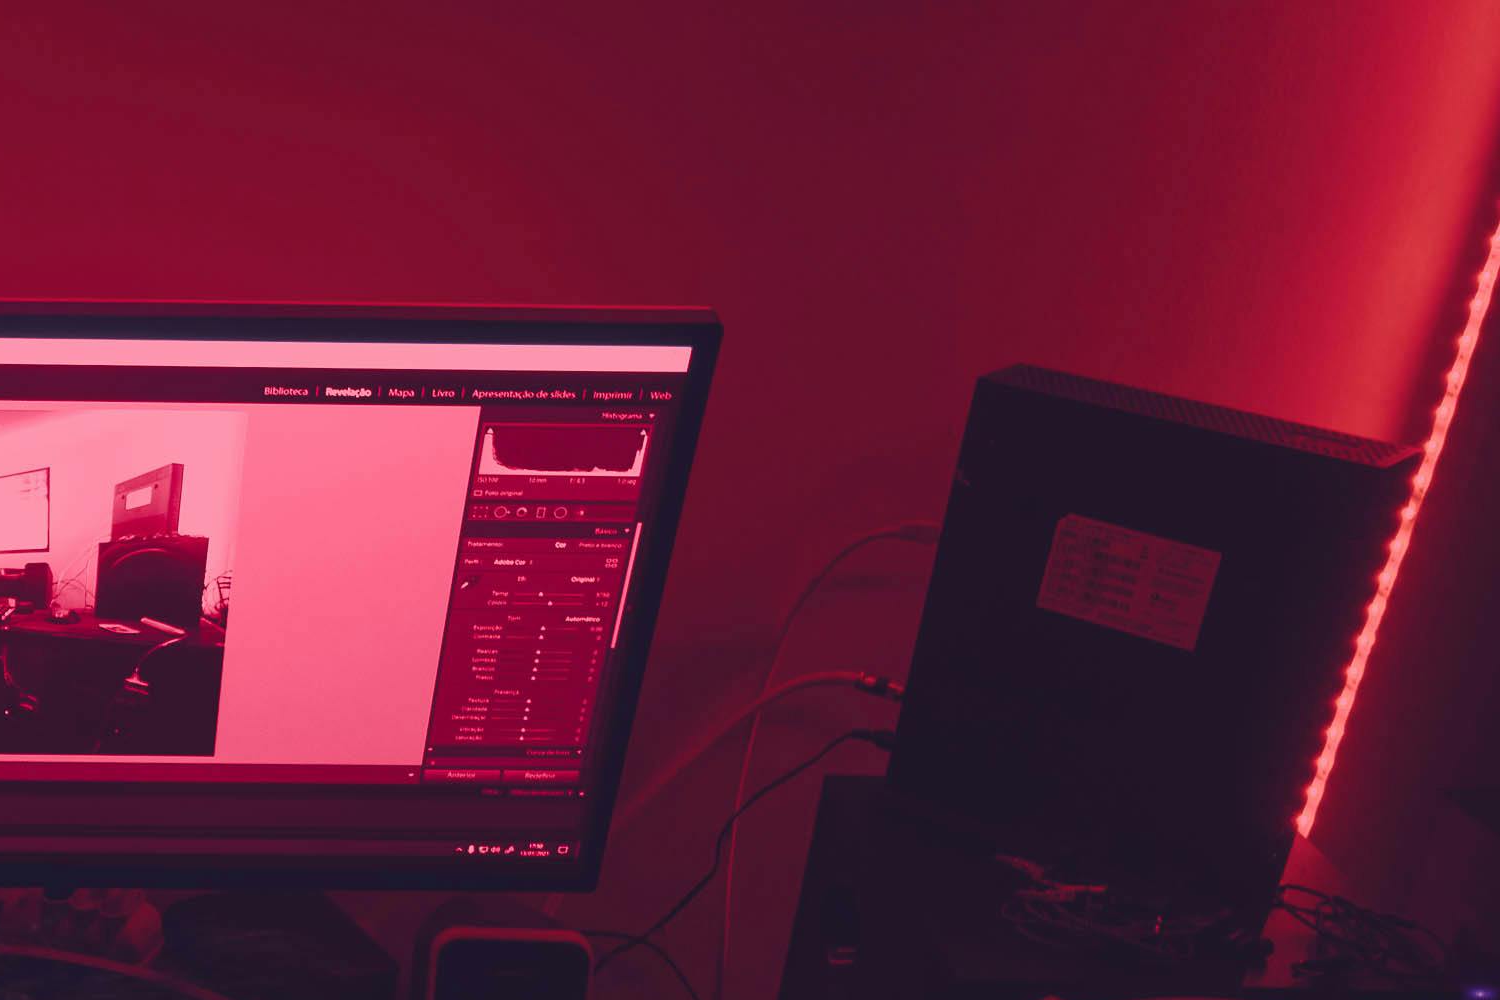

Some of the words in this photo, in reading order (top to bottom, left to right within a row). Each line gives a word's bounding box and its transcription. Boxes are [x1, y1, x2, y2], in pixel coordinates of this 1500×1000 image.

[264, 386, 309, 396] Biblioteca
[325, 387, 372, 398] Revelação
[388, 388, 415, 399] Mapa
[432, 388, 455, 398] Livro
[472, 388, 534, 400] Apresentação
[536, 390, 548, 399] de
[550, 389, 576, 400] slides
[593, 390, 633, 401] Imprimir
[650, 390, 672, 401] Web
[602, 412, 642, 421] Histograma
